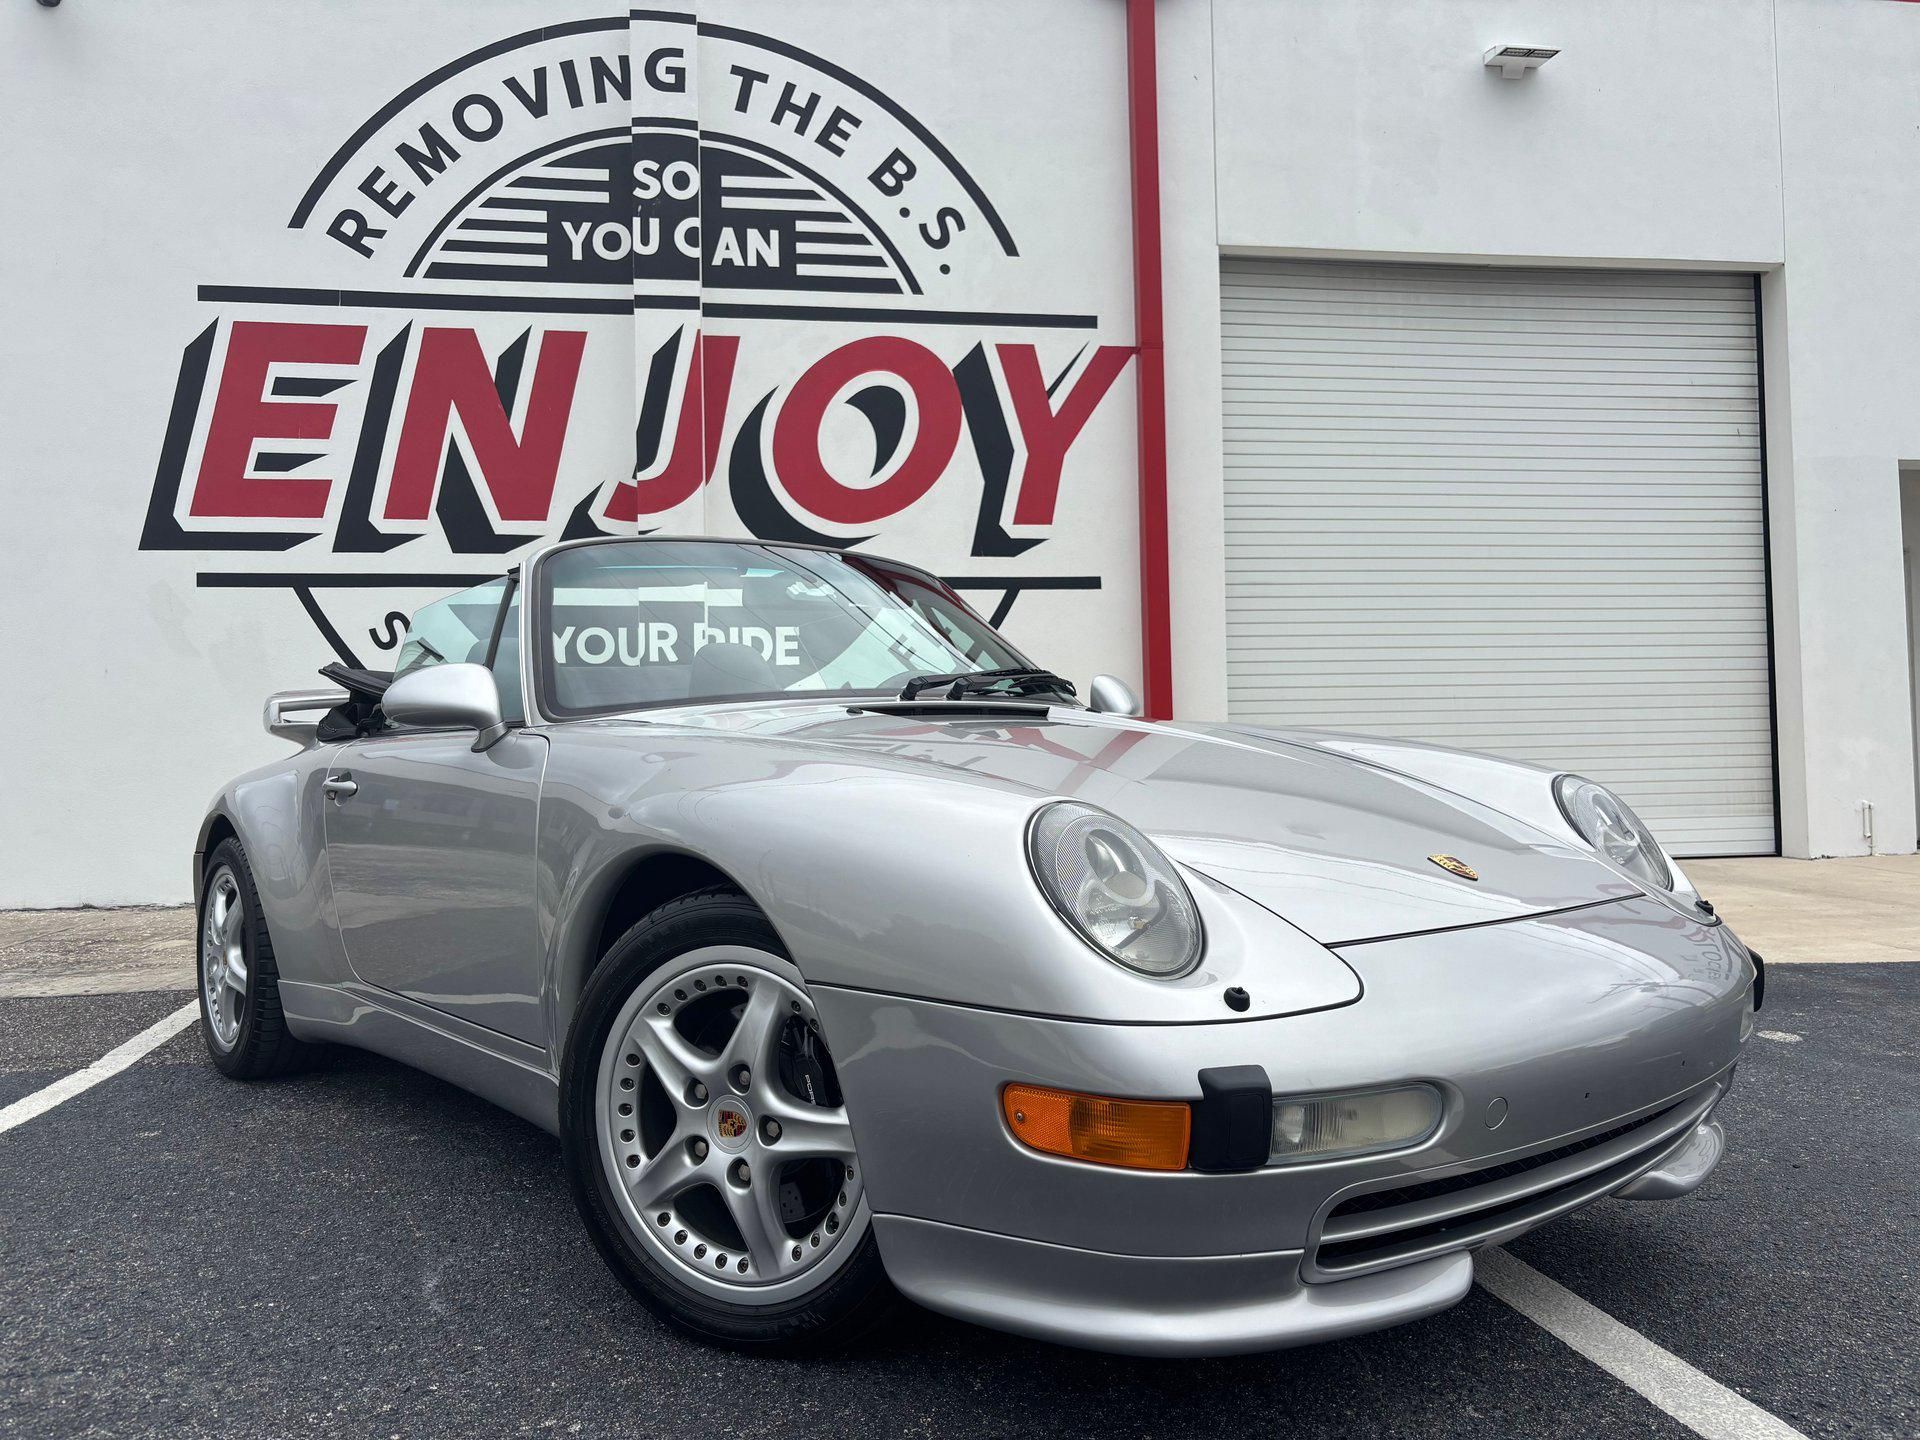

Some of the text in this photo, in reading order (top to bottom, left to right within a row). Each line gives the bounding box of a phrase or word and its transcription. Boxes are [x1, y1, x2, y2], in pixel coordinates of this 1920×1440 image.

[326, 48, 966, 275] REMOVING THE B.S.
[632, 160, 700, 200] SO
[561, 219, 780, 268] YOU CAN
[178, 318, 1137, 535] ENJOY
[553, 622, 679, 667] YOUR
